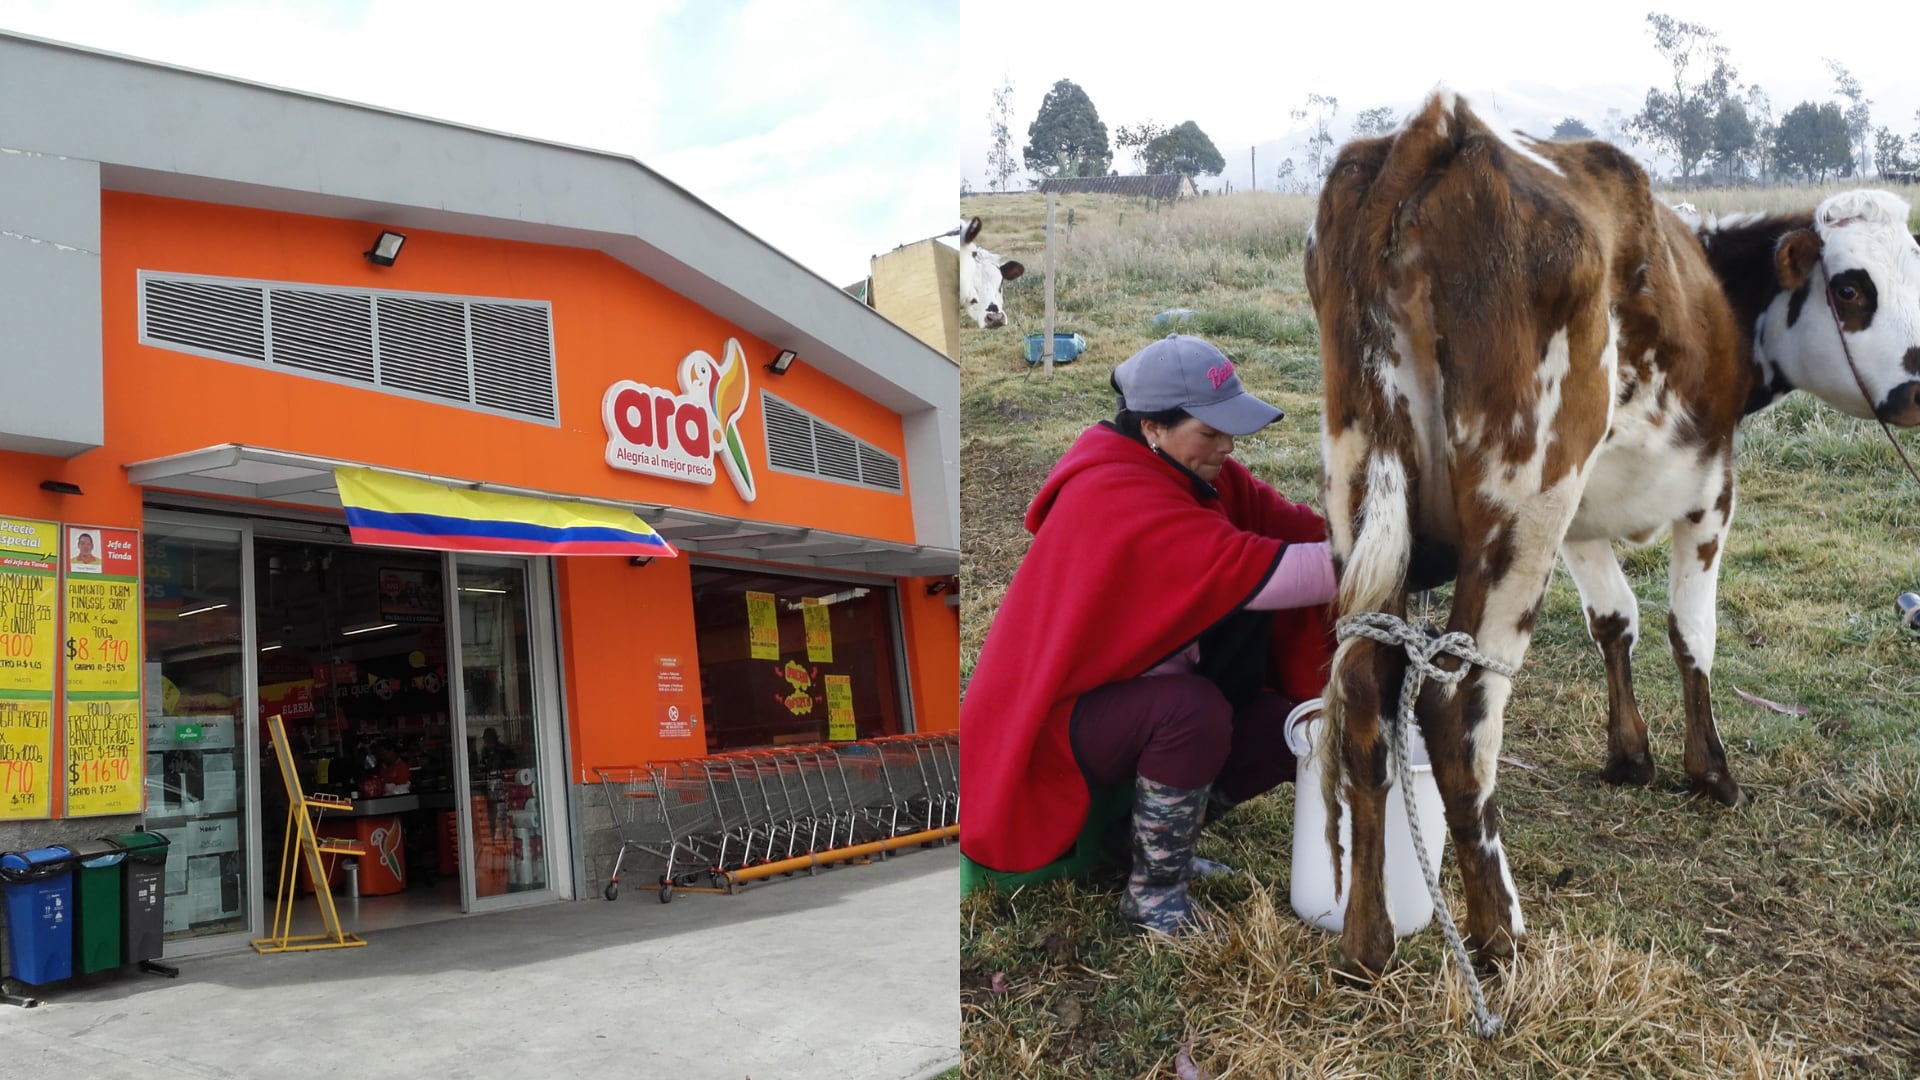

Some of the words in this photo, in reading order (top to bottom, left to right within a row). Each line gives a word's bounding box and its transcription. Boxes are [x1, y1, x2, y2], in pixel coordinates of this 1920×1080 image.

[614, 388, 710, 459] ara
[617, 448, 649, 466] Alegría
[651, 455, 659, 467] al
[661, 458, 686, 473] mejor
[687, 464, 712, 477] precio
[1, 520, 35, 535] Precio
[107, 540, 122, 550] Jefe
[123, 541, 132, 549] de
[108, 551, 132, 560] Tienda
[13, 559, 23, 567] Jefe
[31, 561, 49, 569] Tienda
[72, 597, 105, 610] FINESSE
[69, 611, 90, 624] PACK
